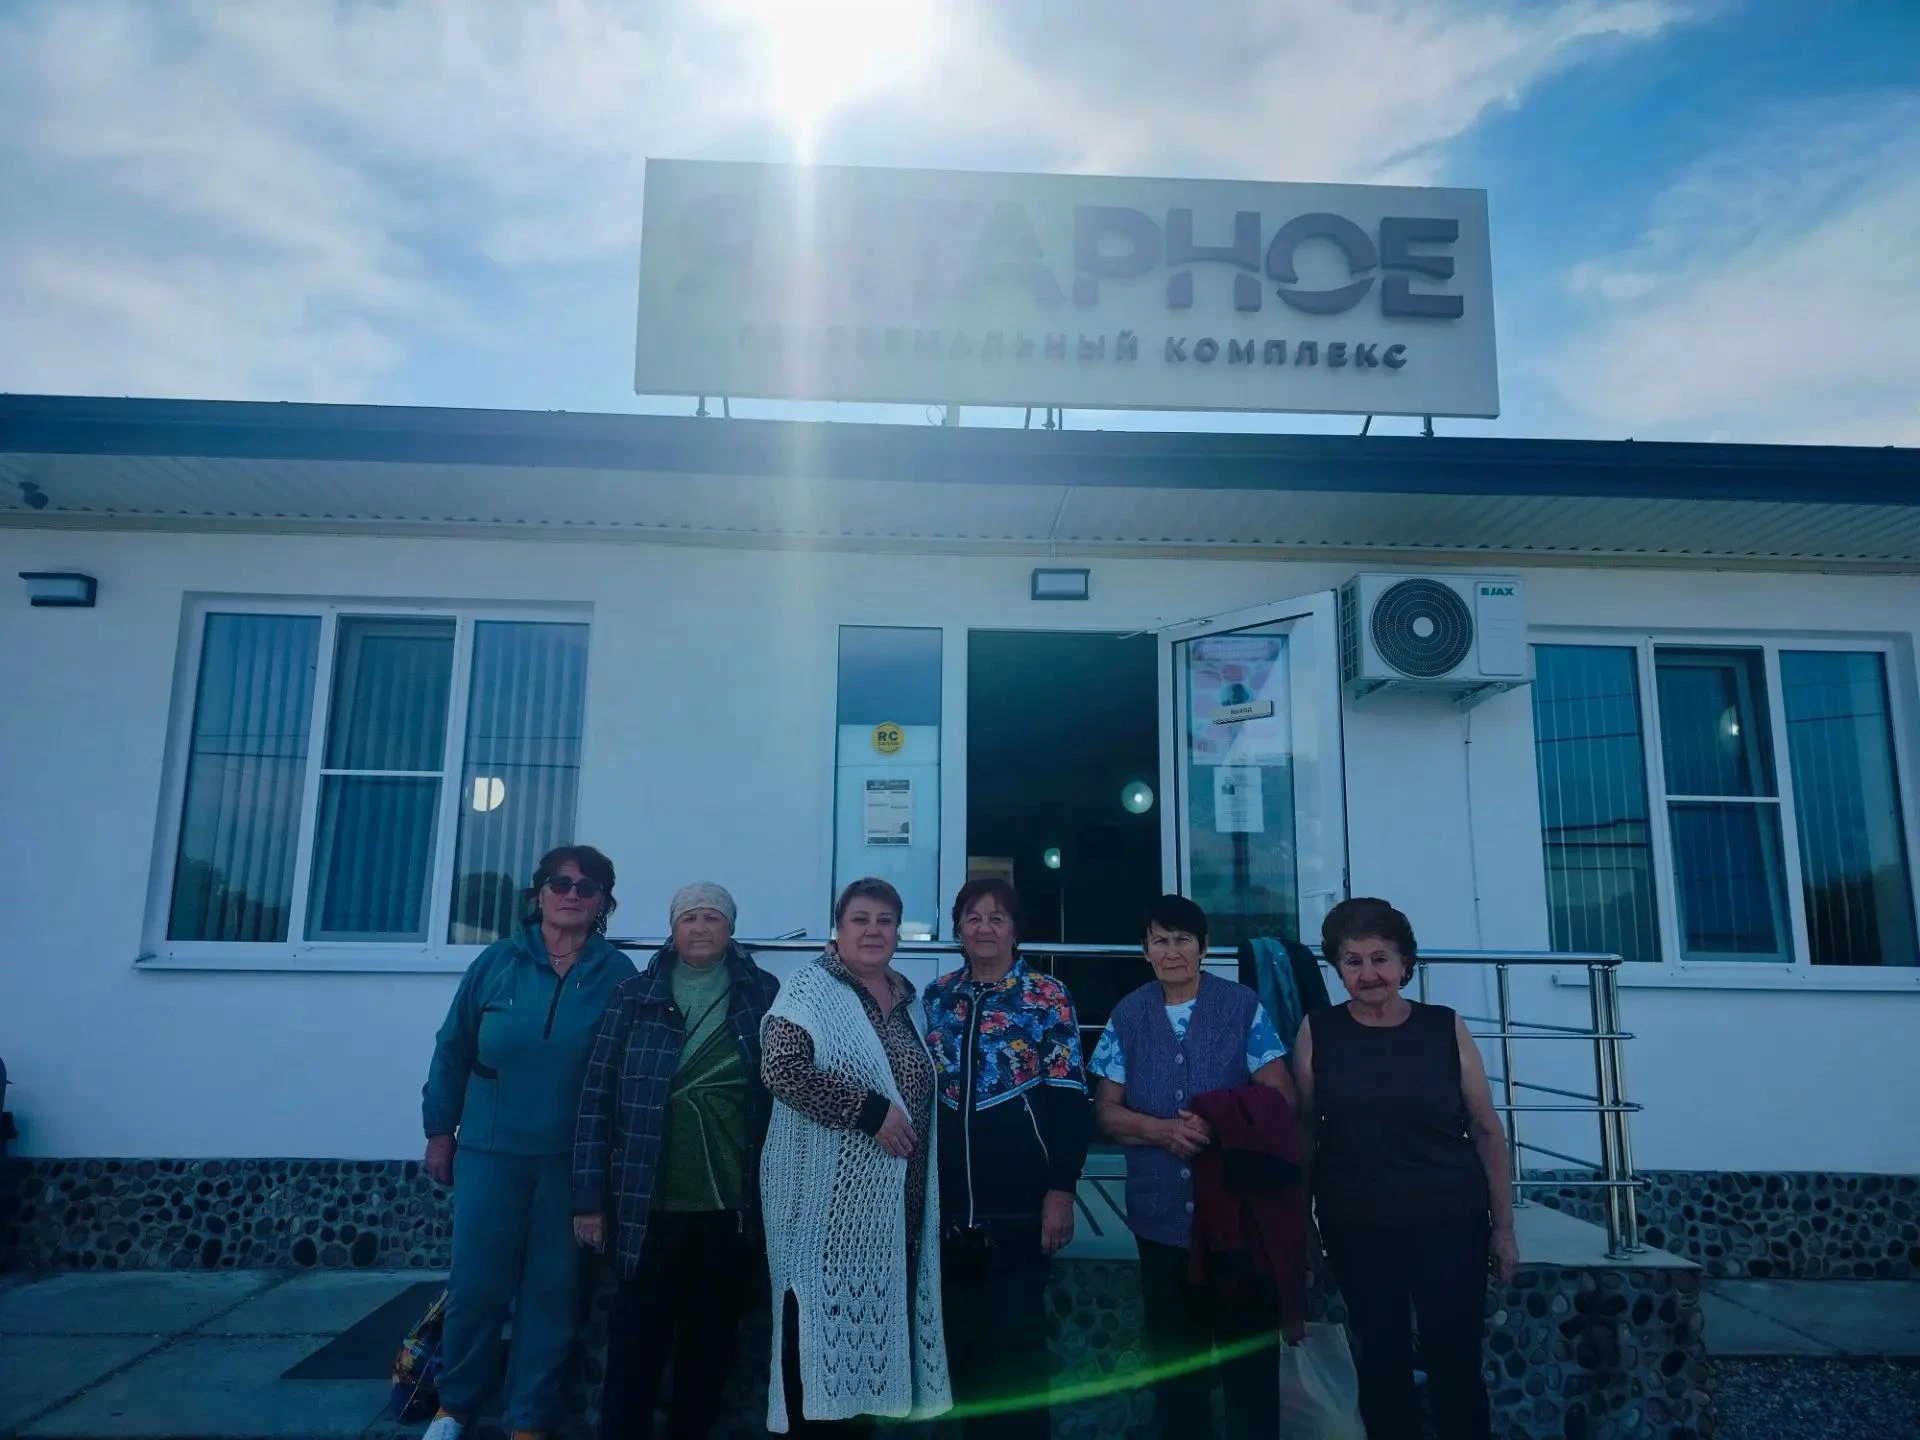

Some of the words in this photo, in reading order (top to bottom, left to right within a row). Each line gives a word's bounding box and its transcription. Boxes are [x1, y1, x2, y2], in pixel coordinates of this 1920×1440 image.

[674, 193, 1464, 319] ЯАРНОЕ
[1164, 335, 1408, 370] КОМПЛЕКС
[878, 731, 898, 742] RC
